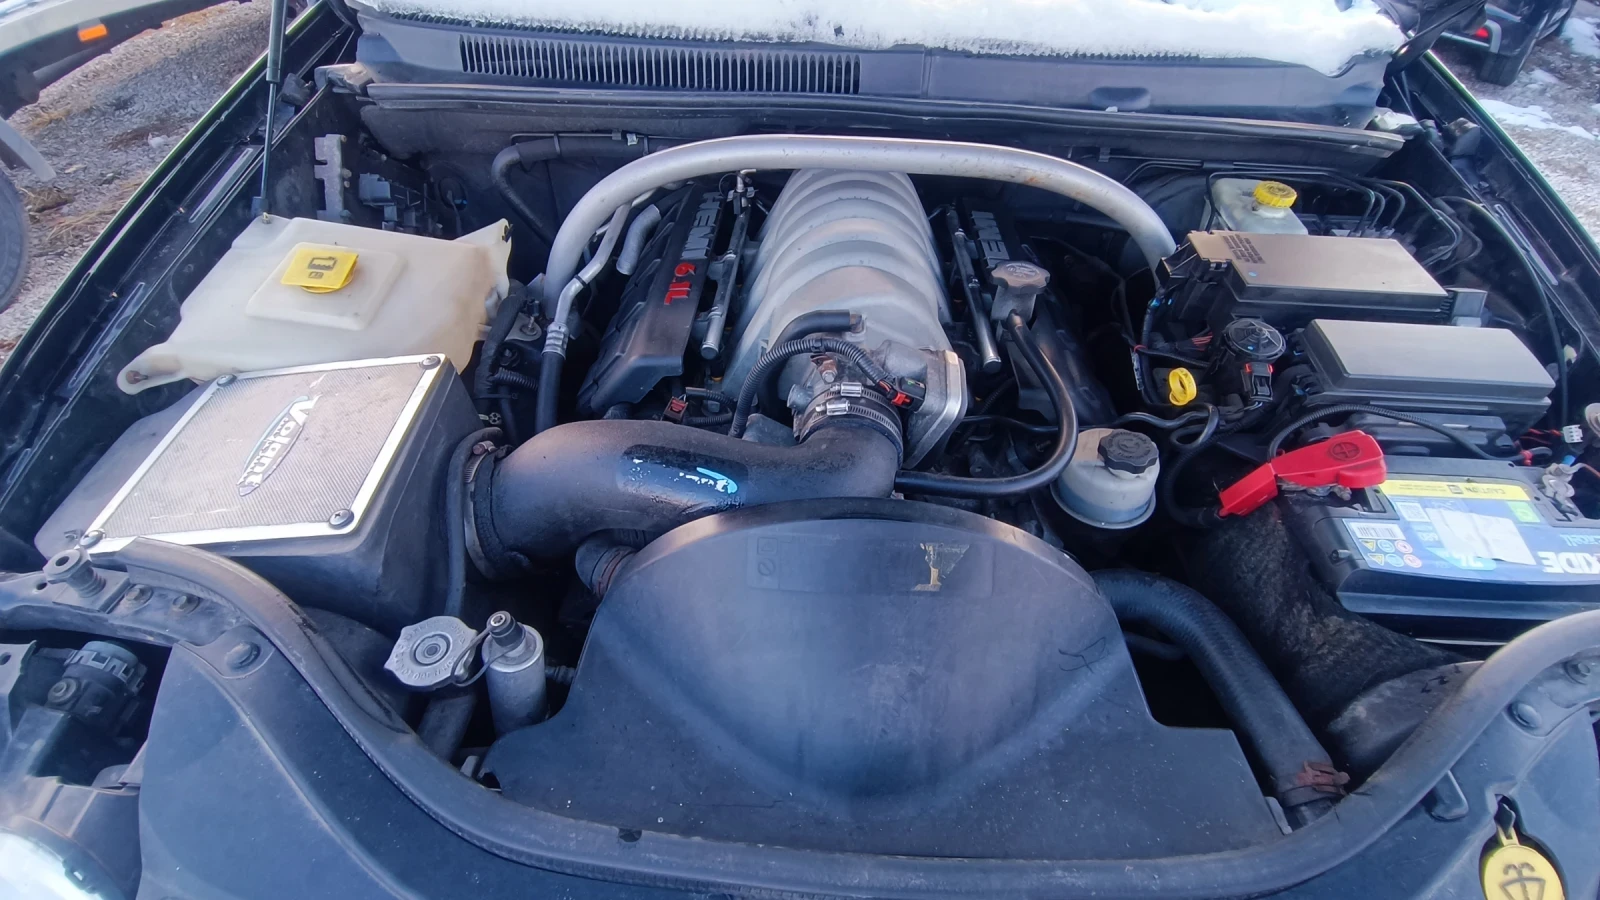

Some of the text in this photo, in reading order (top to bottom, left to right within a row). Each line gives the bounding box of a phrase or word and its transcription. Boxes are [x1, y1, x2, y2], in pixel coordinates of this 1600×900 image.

[664, 192, 723, 305] HEMI 6.1L
[237, 394, 323, 486] Volant
